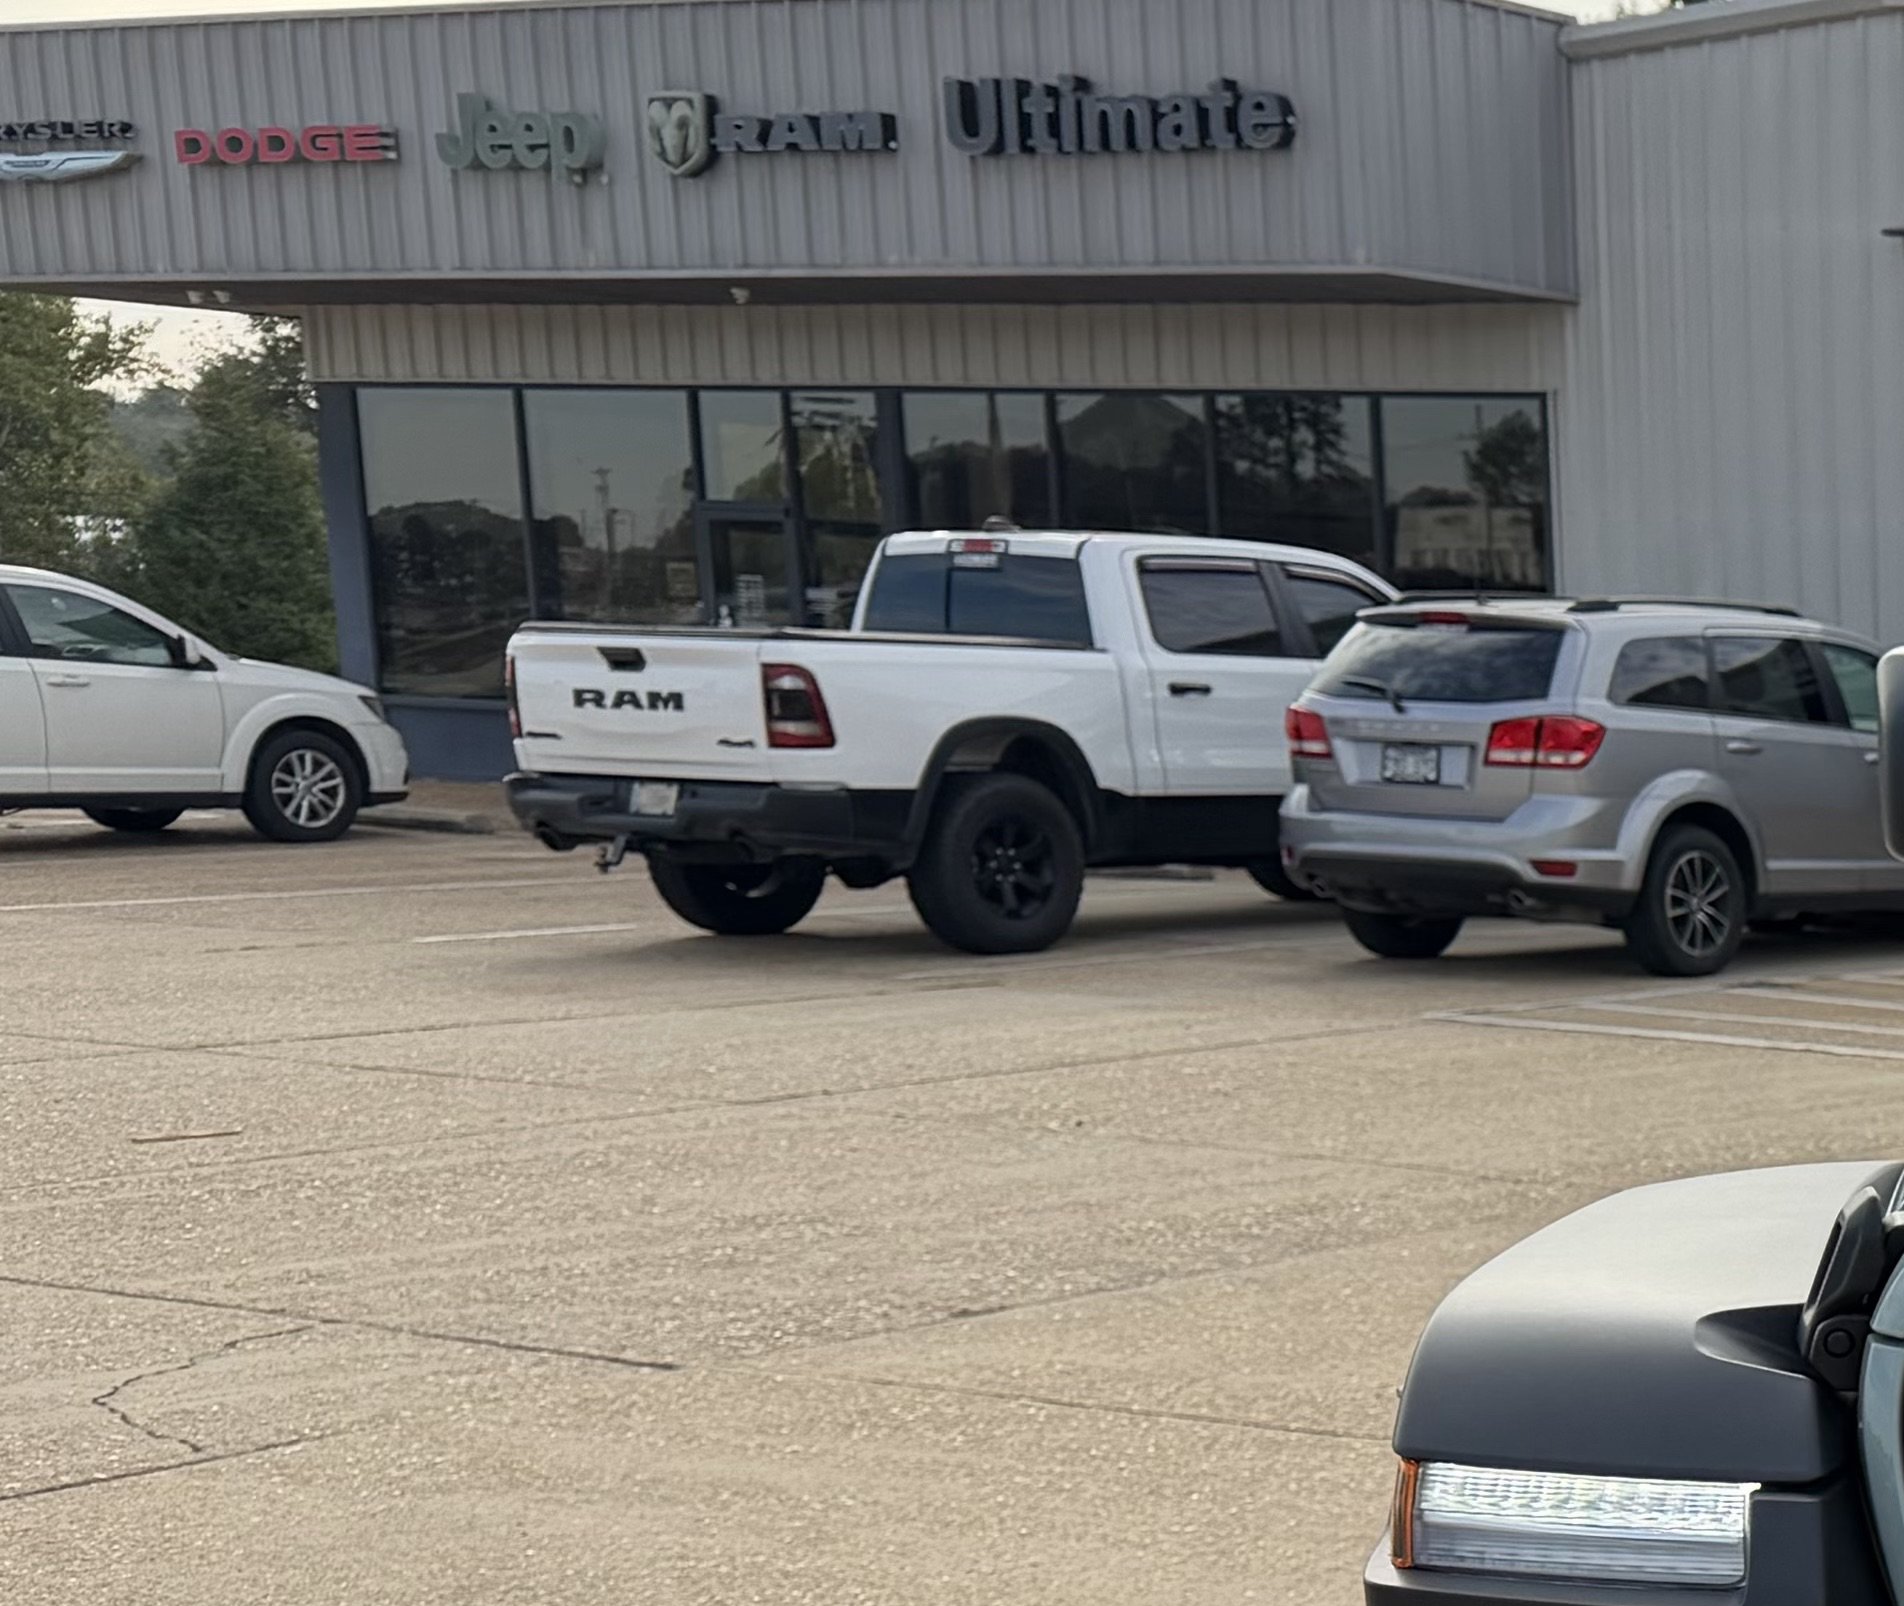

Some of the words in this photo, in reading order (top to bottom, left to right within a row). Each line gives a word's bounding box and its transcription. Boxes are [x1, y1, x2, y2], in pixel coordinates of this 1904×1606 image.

[713, 112, 882, 151] RAM
[943, 75, 1291, 154] Ultimate
[174, 126, 386, 164] DODGE
[435, 93, 596, 184] Jeep
[572, 688, 685, 712] RAM
